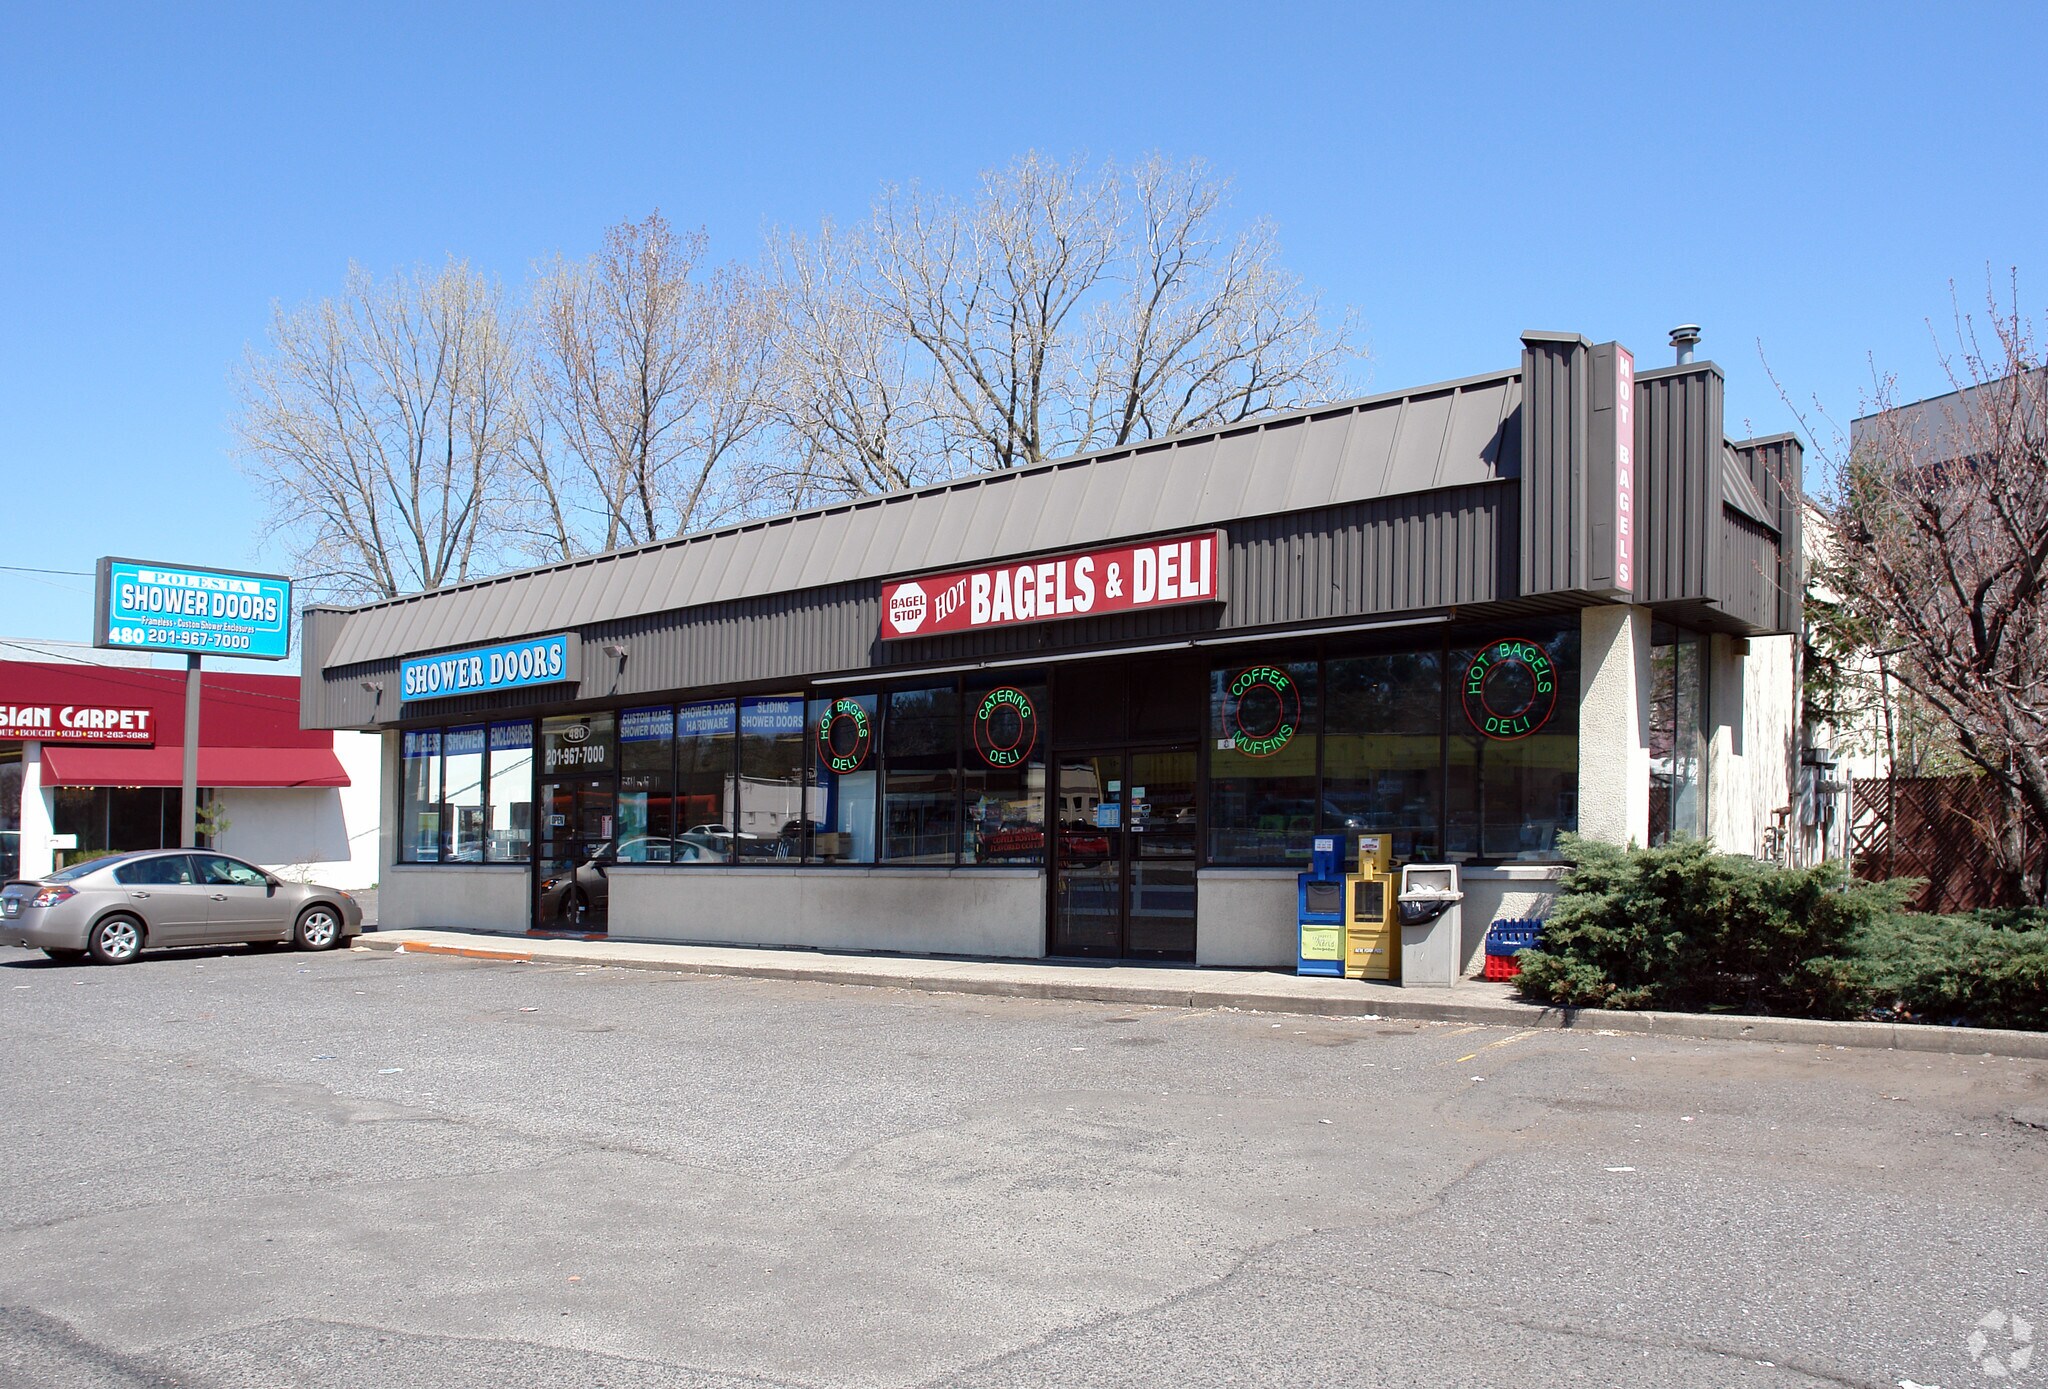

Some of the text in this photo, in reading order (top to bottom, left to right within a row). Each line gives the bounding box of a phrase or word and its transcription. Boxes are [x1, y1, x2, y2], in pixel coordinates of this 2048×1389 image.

[1619, 355, 1630, 582] HOT BAGELS
[154, 573, 247, 592] POLESTA
[934, 539, 1211, 624] HOT BAGELS & DELI
[121, 584, 278, 622] SHOWER DOORS
[891, 594, 926, 610] BAGEL
[894, 608, 922, 622] STOP
[141, 616, 255, 634] Frameless Custom Shower Enclosures
[109, 627, 250, 649] 480 201-967-7000
[405, 644, 562, 695] SHOWER DOORS
[1467, 643, 1552, 694] HOT BAGELS
[1232, 668, 1289, 696] COFFEE
[680, 703, 735, 720] SHOWER DOOR
[757, 702, 789, 714] SLIDING
[979, 690, 1031, 720] CATERING
[59, 706, 150, 730] CARPET
[622, 710, 671, 725] CUSTOM MADE
[686, 717, 729, 732] HARDWARE
[741, 715, 804, 728] SHOWER DOORS
[820, 700, 868, 740] HOT BAGELS
[1485, 716, 1530, 734] DELI
[87, 731, 149, 739] 201-265-5688
[447, 729, 485, 751] SHOWER
[490, 723, 533, 747] ENCLOSURES
[568, 727, 584, 739] 480
[620, 723, 674, 738] SHOWER DOORS
[1232, 724, 1293, 754] MUFFINS
[832, 756, 858, 770] DELI
[989, 749, 1020, 764] DELI
